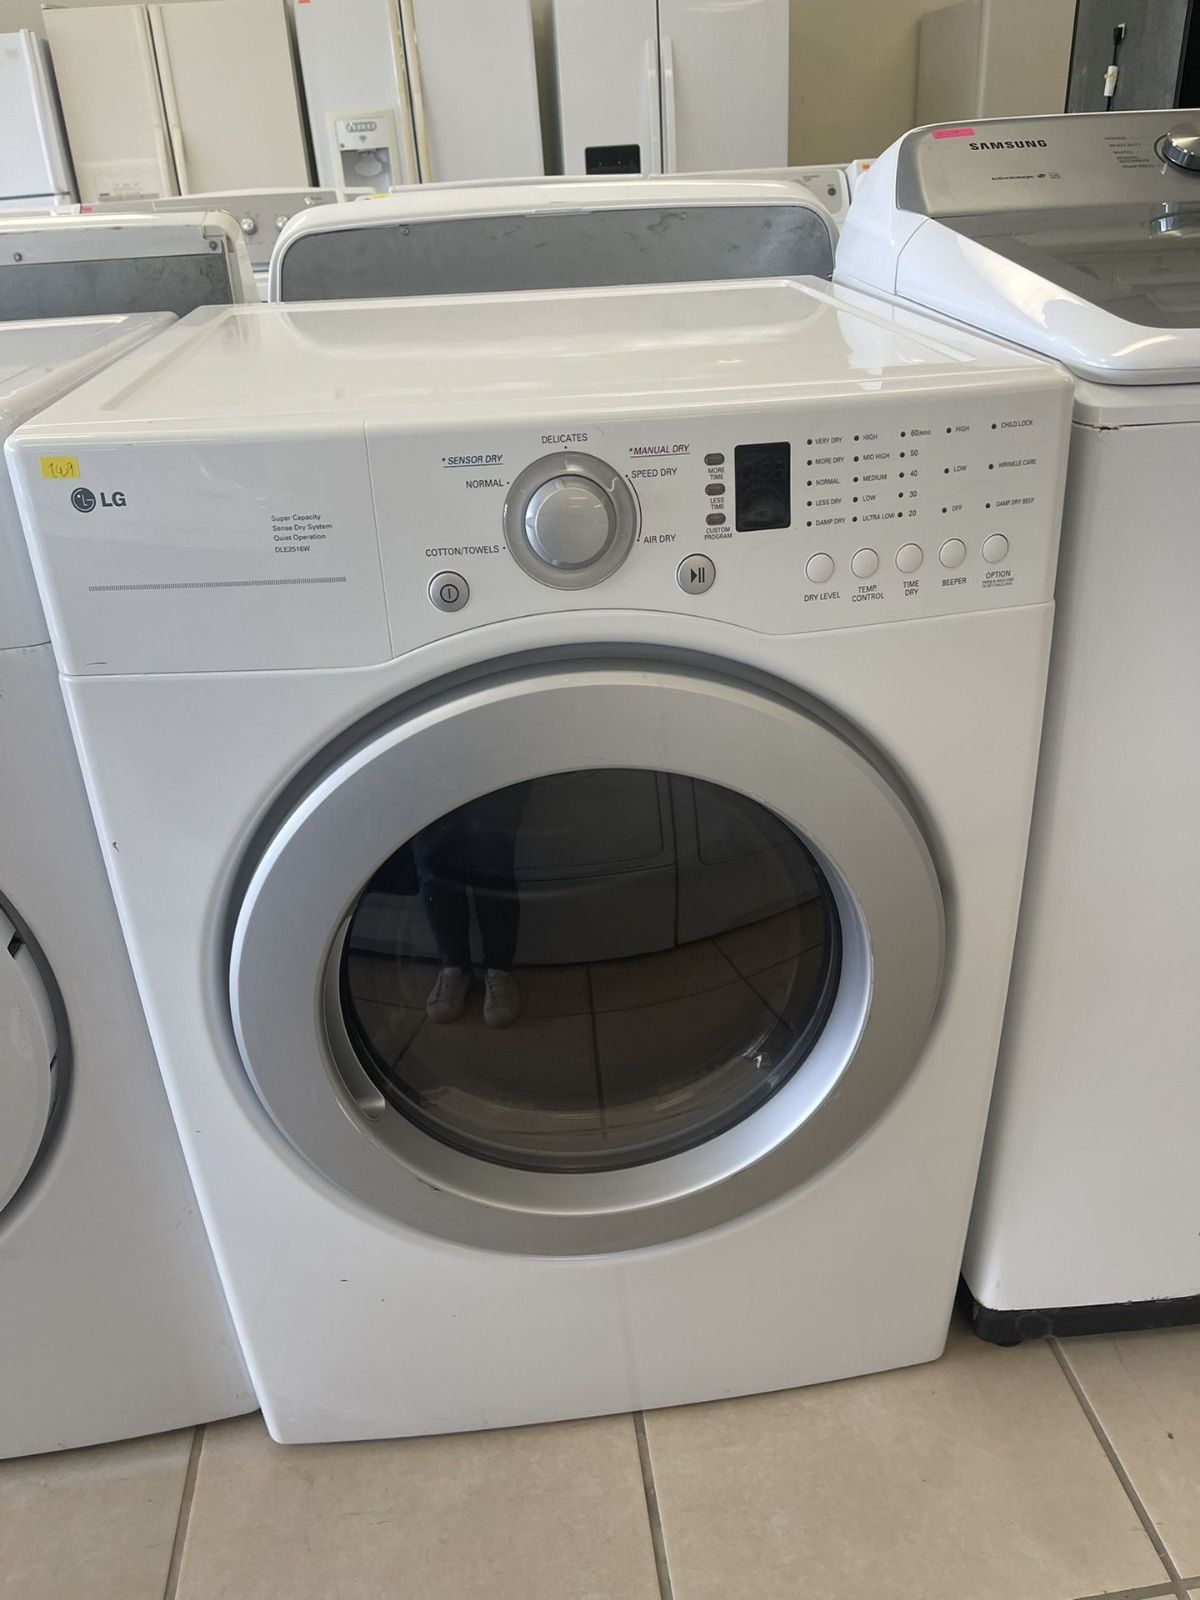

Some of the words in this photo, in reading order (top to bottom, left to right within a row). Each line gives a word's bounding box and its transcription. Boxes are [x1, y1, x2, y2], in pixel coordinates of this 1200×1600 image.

[969, 139, 1047, 151] SAMSUNG
[1018, 419, 1033, 427] LOCK
[541, 433, 588, 444] DELICATES
[815, 437, 830, 445] VERY
[863, 433, 878, 441] HIGH
[672, 444, 690, 454] DRY
[910, 449, 918, 457] 50
[485, 454, 503, 464] DRY
[815, 457, 831, 465] MORE
[833, 456, 844, 464] DRY
[998, 460, 1021, 468] WRINKLE
[1022, 458, 1037, 466] CARE
[631, 468, 658, 478] SPEED
[660, 468, 678, 477] DRY
[910, 470, 918, 478] 40
[863, 474, 887, 482] MEDIUM
[466, 478, 504, 489] NORMAL
[909, 490, 917, 498] 30
[100, 491, 126, 507] LG
[271, 514, 291, 523] Super
[292, 513, 321, 522] Capacity
[862, 514, 880, 522] ULTRA
[272, 524, 292, 532] Sense
[295, 524, 305, 532] Dry
[308, 522, 332, 531] System
[273, 534, 291, 542] Quiet
[293, 533, 326, 542] Operation
[643, 535, 656, 544] AIR
[658, 534, 676, 543] DRY
[704, 532, 732, 540] PROGRAM
[275, 545, 310, 553] DLE2516W
[425, 545, 500, 558] COTTON/TOWELS
[986, 570, 1011, 578] OPTION
[904, 580, 919, 588] TIME
[942, 577, 967, 586] BEEPER
[804, 593, 818, 602] DRY
[820, 591, 841, 600] LEVEL
[905, 588, 919, 597] DRY
[852, 592, 884, 603] CONTROL
